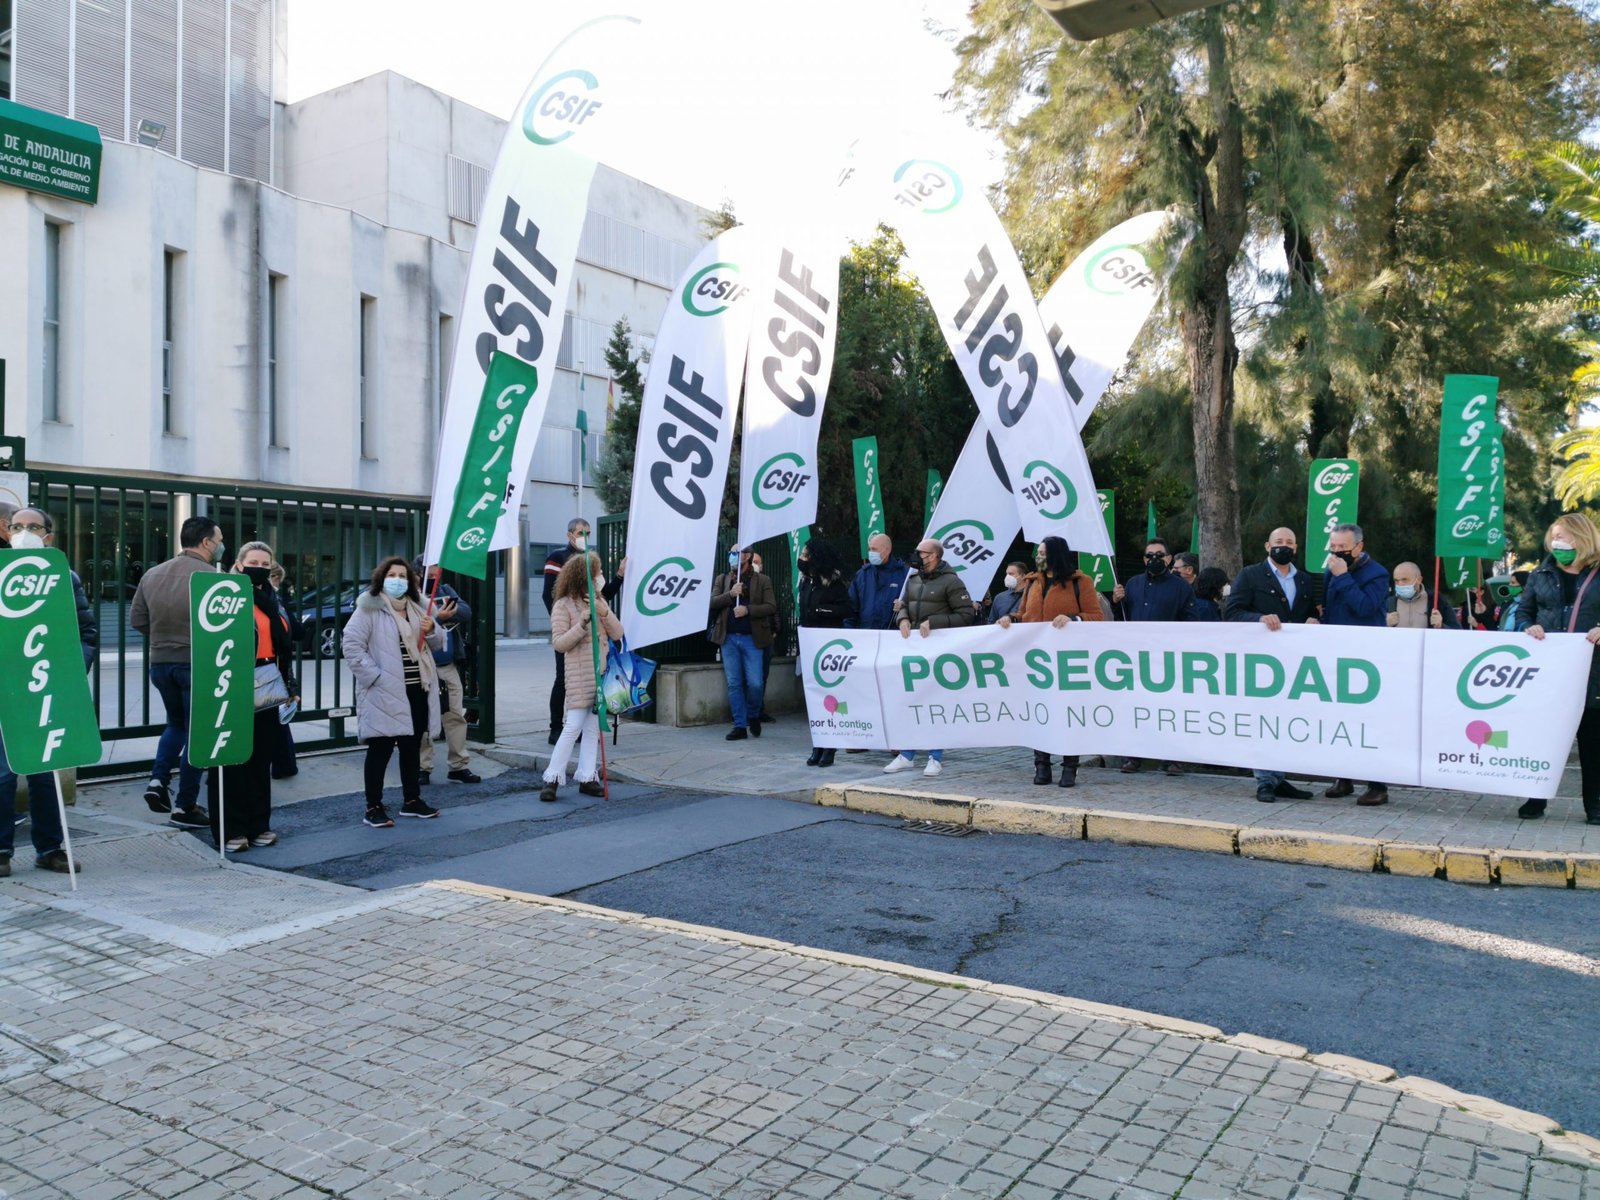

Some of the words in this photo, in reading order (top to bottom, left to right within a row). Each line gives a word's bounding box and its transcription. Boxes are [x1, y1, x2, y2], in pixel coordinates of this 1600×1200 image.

[539, 91, 602, 125] CSIF
[4, 134, 20, 151] DE
[10, 167, 22, 177] DE
[23, 171, 50, 184] MEDIO
[51, 178, 90, 194] AMBIENTE
[32, 161, 47, 172] DEL
[50, 166, 91, 183] GOBIERNO
[1101, 257, 1154, 289] CSIF
[697, 277, 749, 302] CSIF
[762, 247, 830, 418] CSIF
[650, 354, 723, 520] CSIF
[763, 469, 811, 493] CSIF
[1322, 472, 1354, 484] CSIF
[943, 532, 995, 565] CSIF
[5, 575, 61, 597] CSIF
[648, 574, 702, 599] CSIF
[208, 595, 247, 615] CSIF
[820, 654, 857, 672] CSIF
[901, 652, 1010, 692] POR
[1025, 648, 1381, 704] SEGURIDAD
[1473, 664, 1540, 689] CSIF
[23, 624, 65, 763] CSIF
[210, 639, 235, 759] CSIF
[810, 720, 825, 728] por
[838, 719, 873, 731] contigo
[908, 700, 1049, 726] TRABAJO
[1067, 704, 1114, 728] NO
[1134, 707, 1378, 749] PRESENCIAL
[1438, 752, 1465, 764] por
[1469, 753, 1484, 767] ti,
[1489, 757, 1551, 772] contigo
